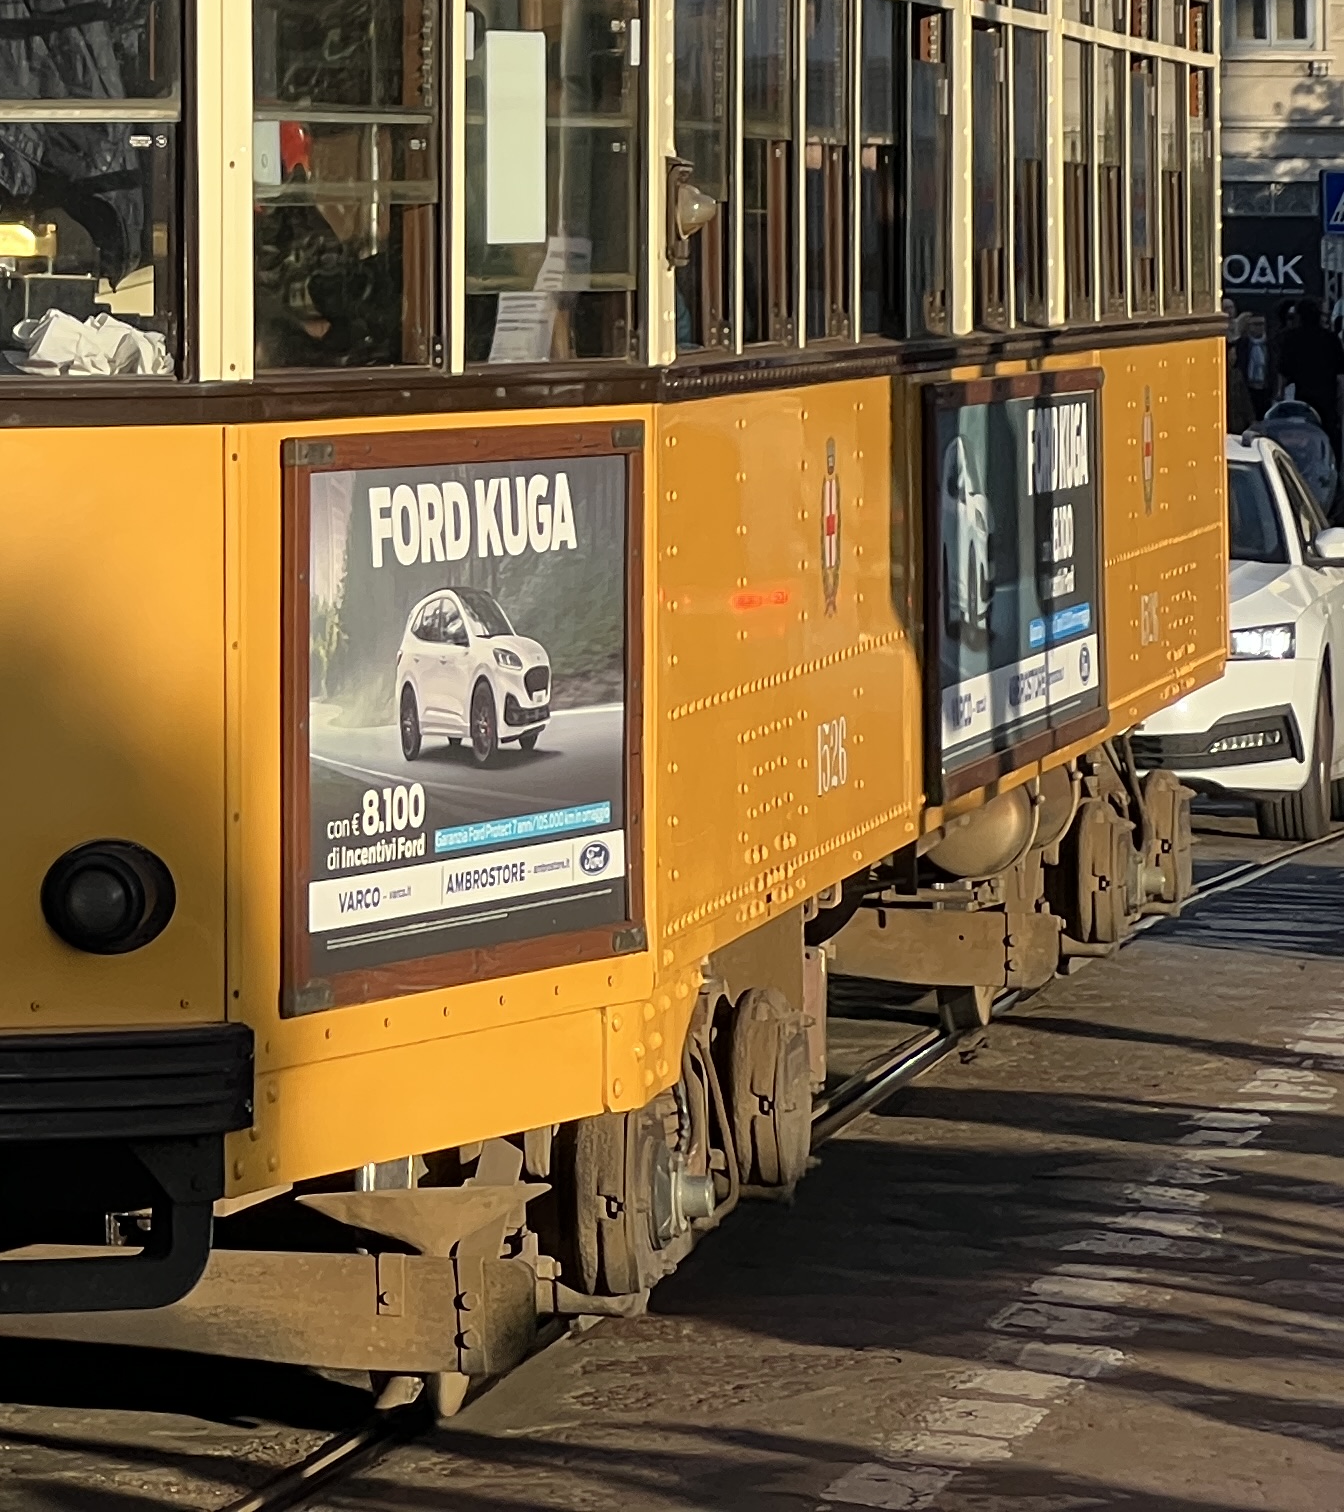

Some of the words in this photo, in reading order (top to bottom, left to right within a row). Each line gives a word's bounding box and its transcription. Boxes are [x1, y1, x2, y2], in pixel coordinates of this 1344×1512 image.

[1223, 254, 1304, 285] OAK
[368, 481, 471, 568] FORD
[474, 472, 577, 558] KUGA
[816, 714, 848, 798] 1526
[327, 819, 350, 840] con
[351, 812, 360, 836] €
[362, 782, 425, 836] 8.100
[327, 845, 340, 870] di
[341, 837, 396, 869] Incentivi
[397, 833, 425, 860] Ford
[446, 861, 526, 895] AMBROSTORE
[338, 886, 381, 914] VARCO
